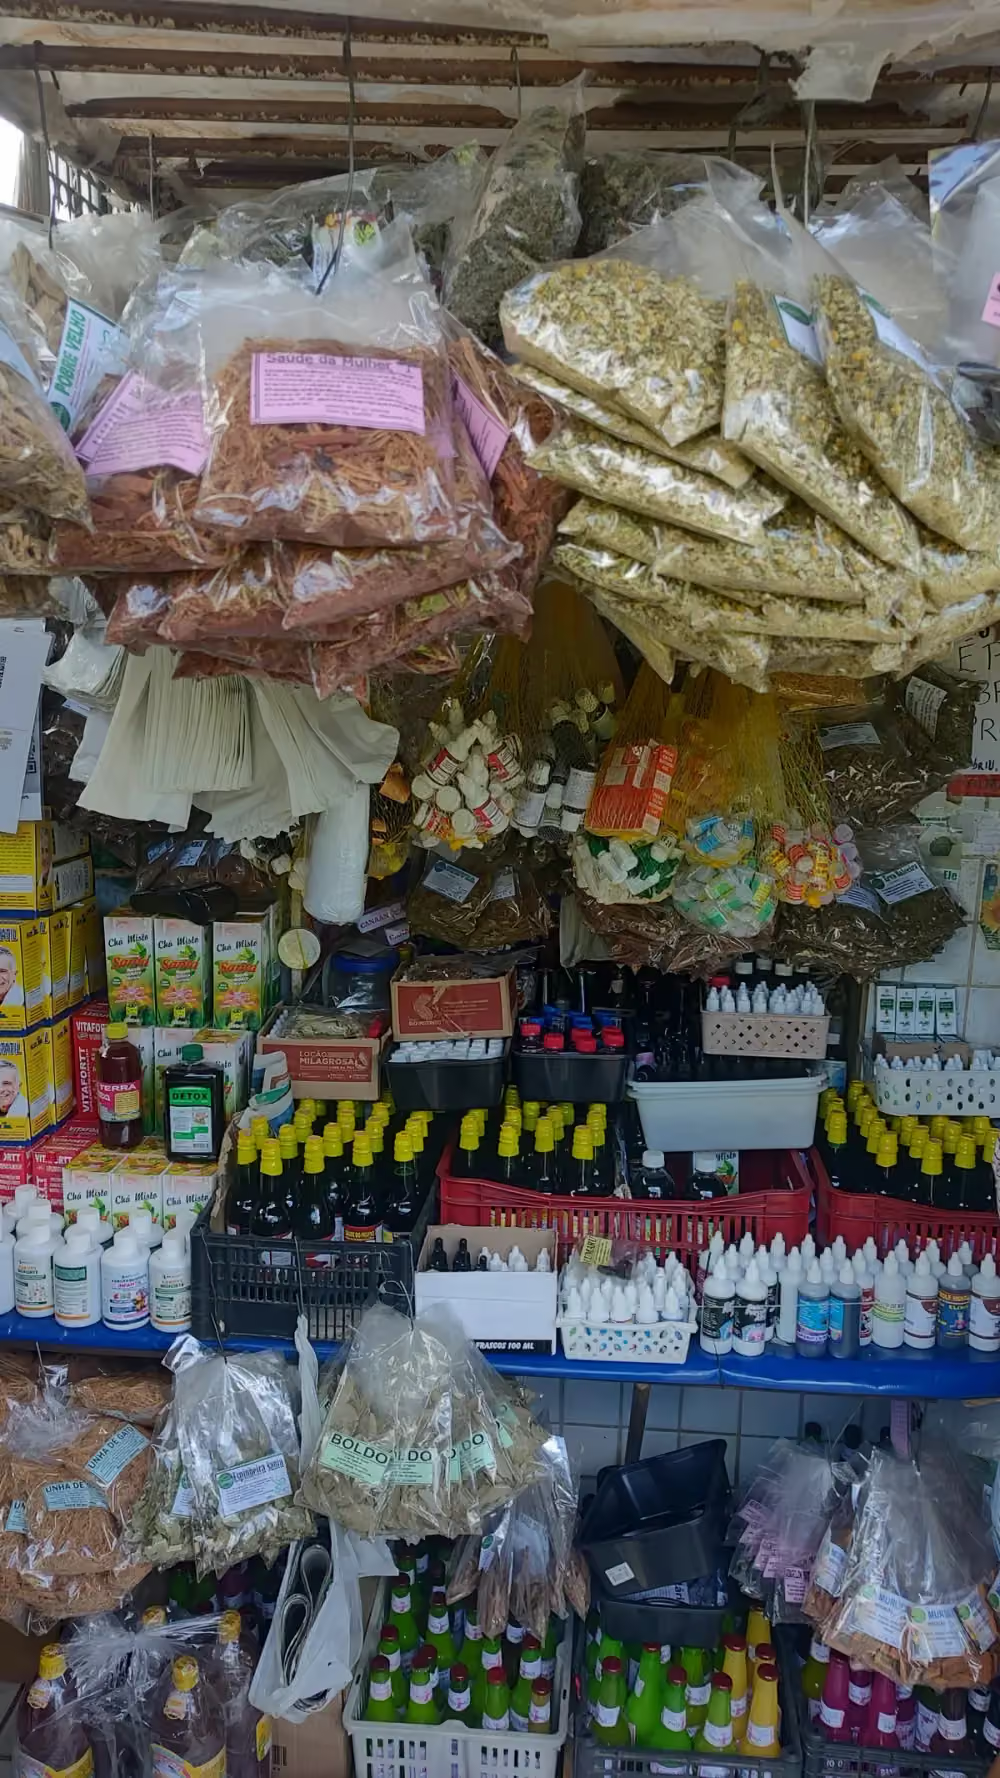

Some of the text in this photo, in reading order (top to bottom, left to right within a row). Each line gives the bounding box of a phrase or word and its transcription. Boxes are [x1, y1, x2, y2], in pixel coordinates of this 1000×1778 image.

[54, 309, 86, 396] POBRE VELHO
[299, 1057, 356, 1065] MILAGROSA
[172, 1092, 209, 1100] DETOX
[66, 1189, 108, 1201] Chá Misto
[115, 1192, 158, 1204] Chá Misto
[166, 1193, 209, 1206] Chá Misto
[475, 1340, 535, 1350] FRASCOS 100 ML
[87, 1426, 134, 1469] UNHA DE GATO
[330, 1433, 388, 1464] BOLDO
[45, 1481, 84, 1493] UNHA DE
